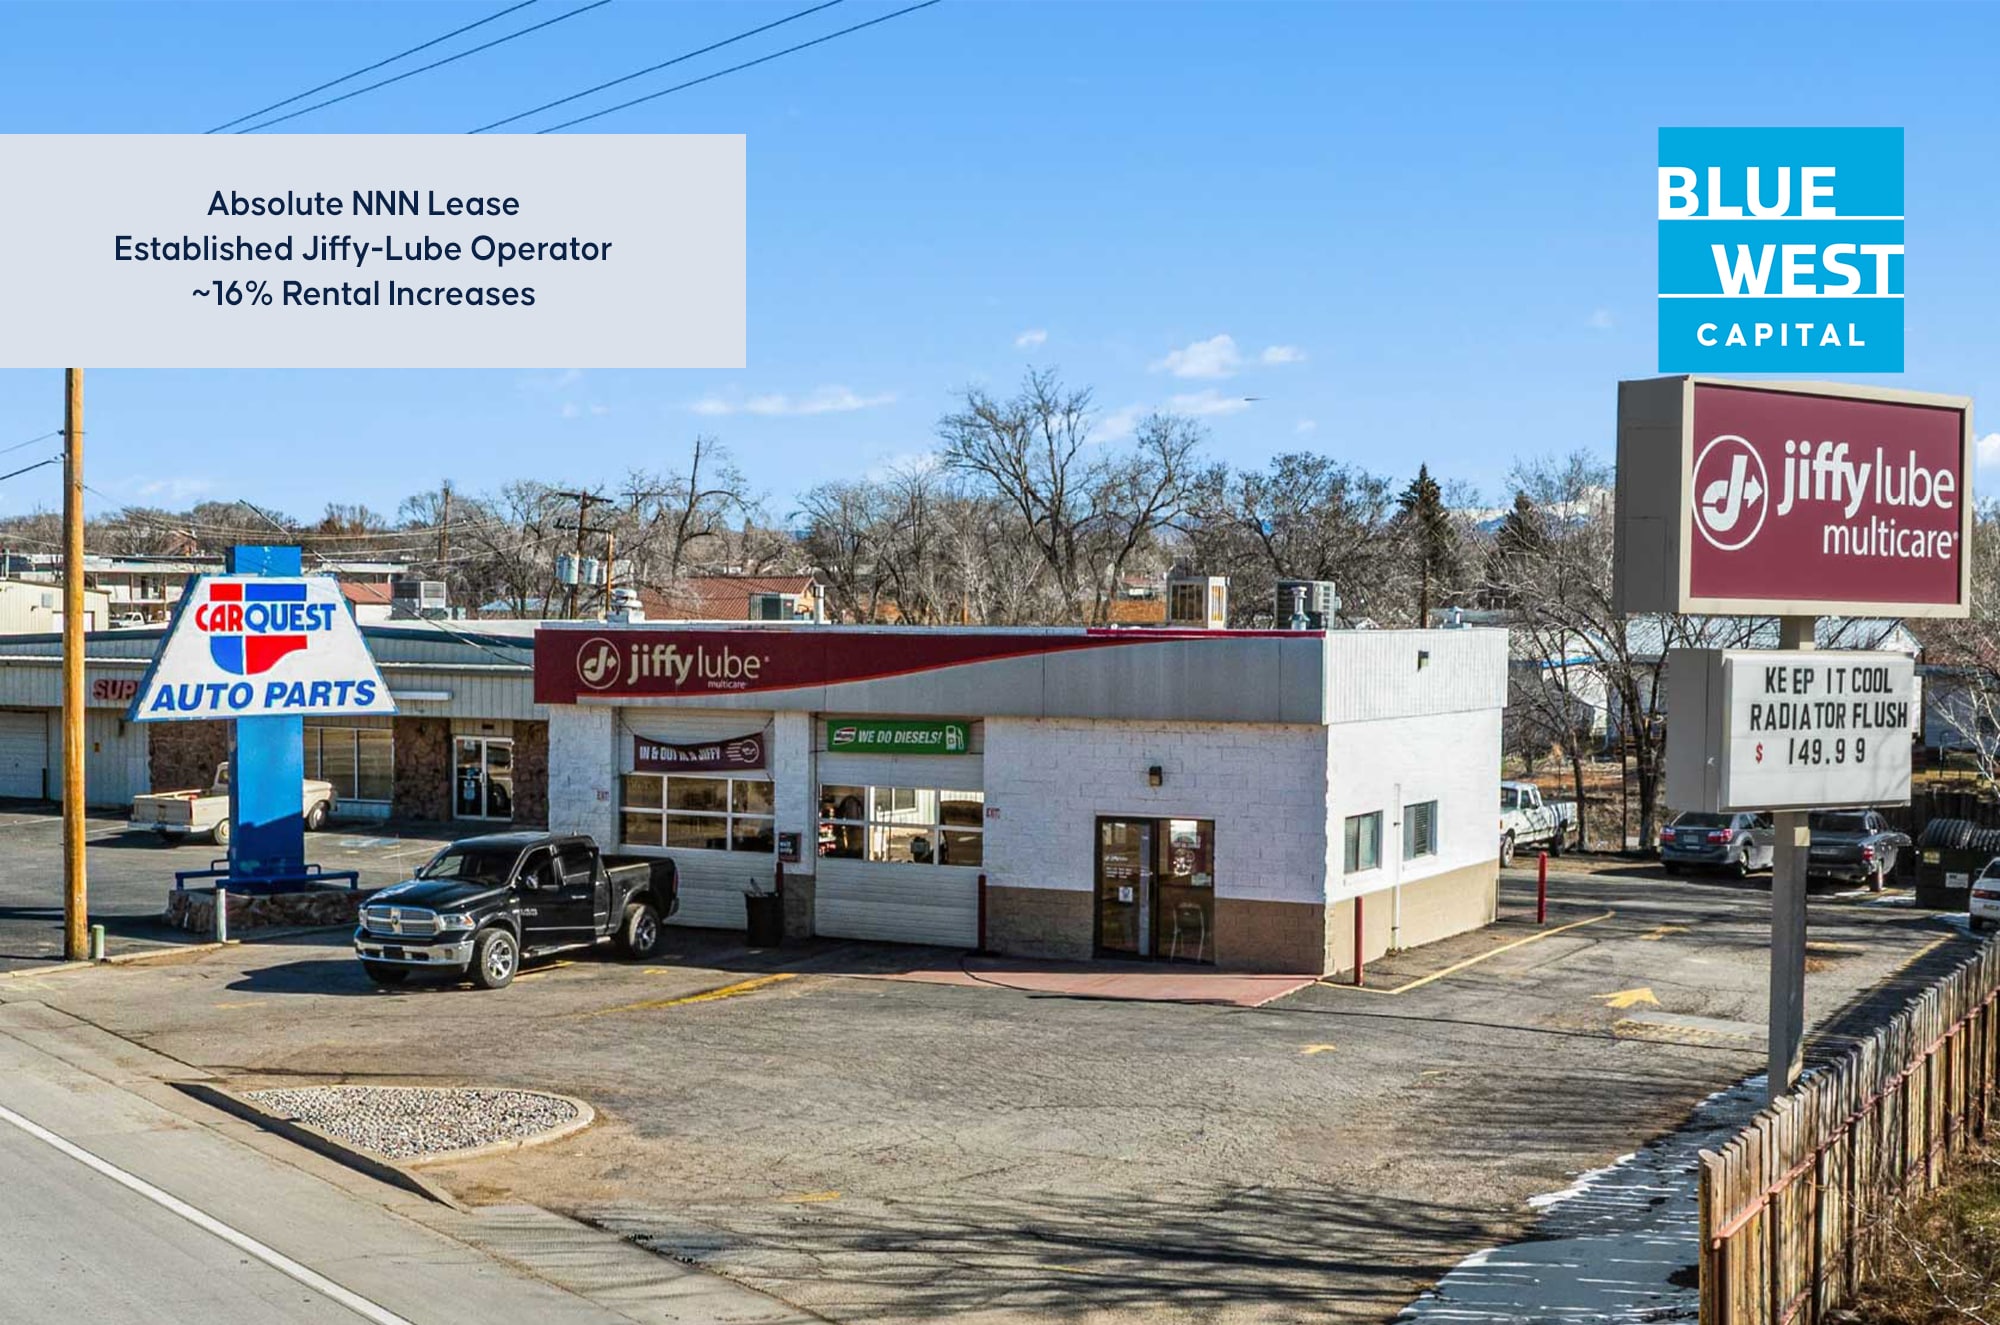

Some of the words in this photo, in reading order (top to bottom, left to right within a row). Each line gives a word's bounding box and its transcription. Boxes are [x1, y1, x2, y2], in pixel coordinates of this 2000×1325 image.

[1823, 515, 1953, 559] multicare
[195, 603, 336, 633] CARQUEST
[93, 679, 140, 700] SUP
[707, 680, 746, 690] multicare
[1765, 666, 1815, 694] KEEP
[1827, 667, 1846, 694] IT
[1851, 667, 1893, 693] COOL
[151, 682, 253, 711] AUTO
[264, 680, 377, 708] PARTS
[1750, 701, 1846, 731] RADIATOR
[1852, 701, 1908, 728] FLUSH
[858, 730, 875, 744] WE
[877, 730, 892, 744] DO
[894, 731, 943, 745] DIESELS!
[640, 746, 650, 760] IN
